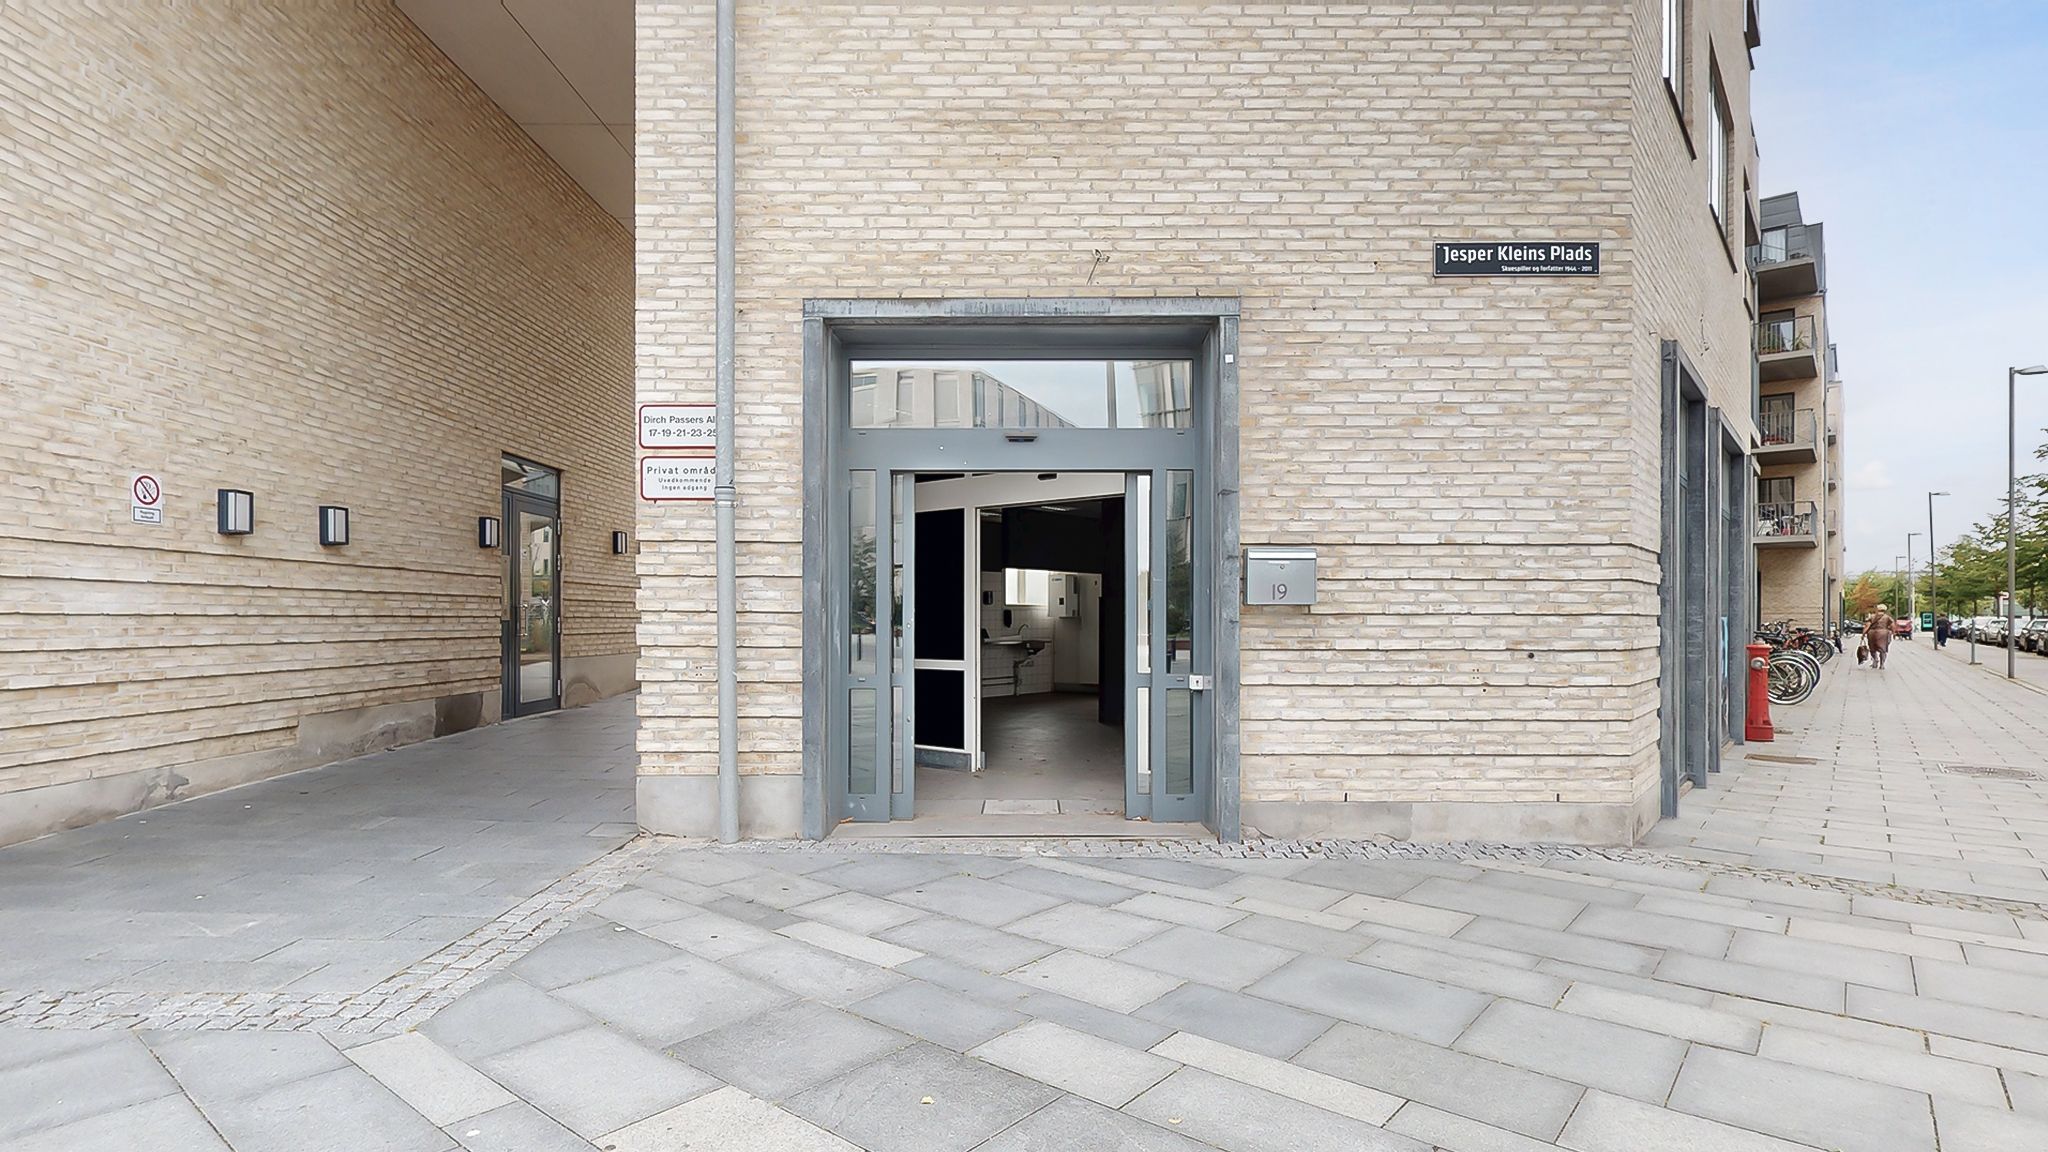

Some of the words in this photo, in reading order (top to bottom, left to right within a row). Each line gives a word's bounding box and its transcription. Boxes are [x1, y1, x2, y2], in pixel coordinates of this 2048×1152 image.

[1443, 246, 1493, 263] Jesper
[1498, 246, 1545, 261] Kleins
[1551, 246, 1592, 261] Plads
[643, 415, 667, 424] Dirch
[669, 415, 704, 424] Passers
[706, 415, 716, 424] Al
[646, 466, 679, 475] Privat
[682, 466, 716, 475] områd
[1272, 583, 1288, 601] 19
